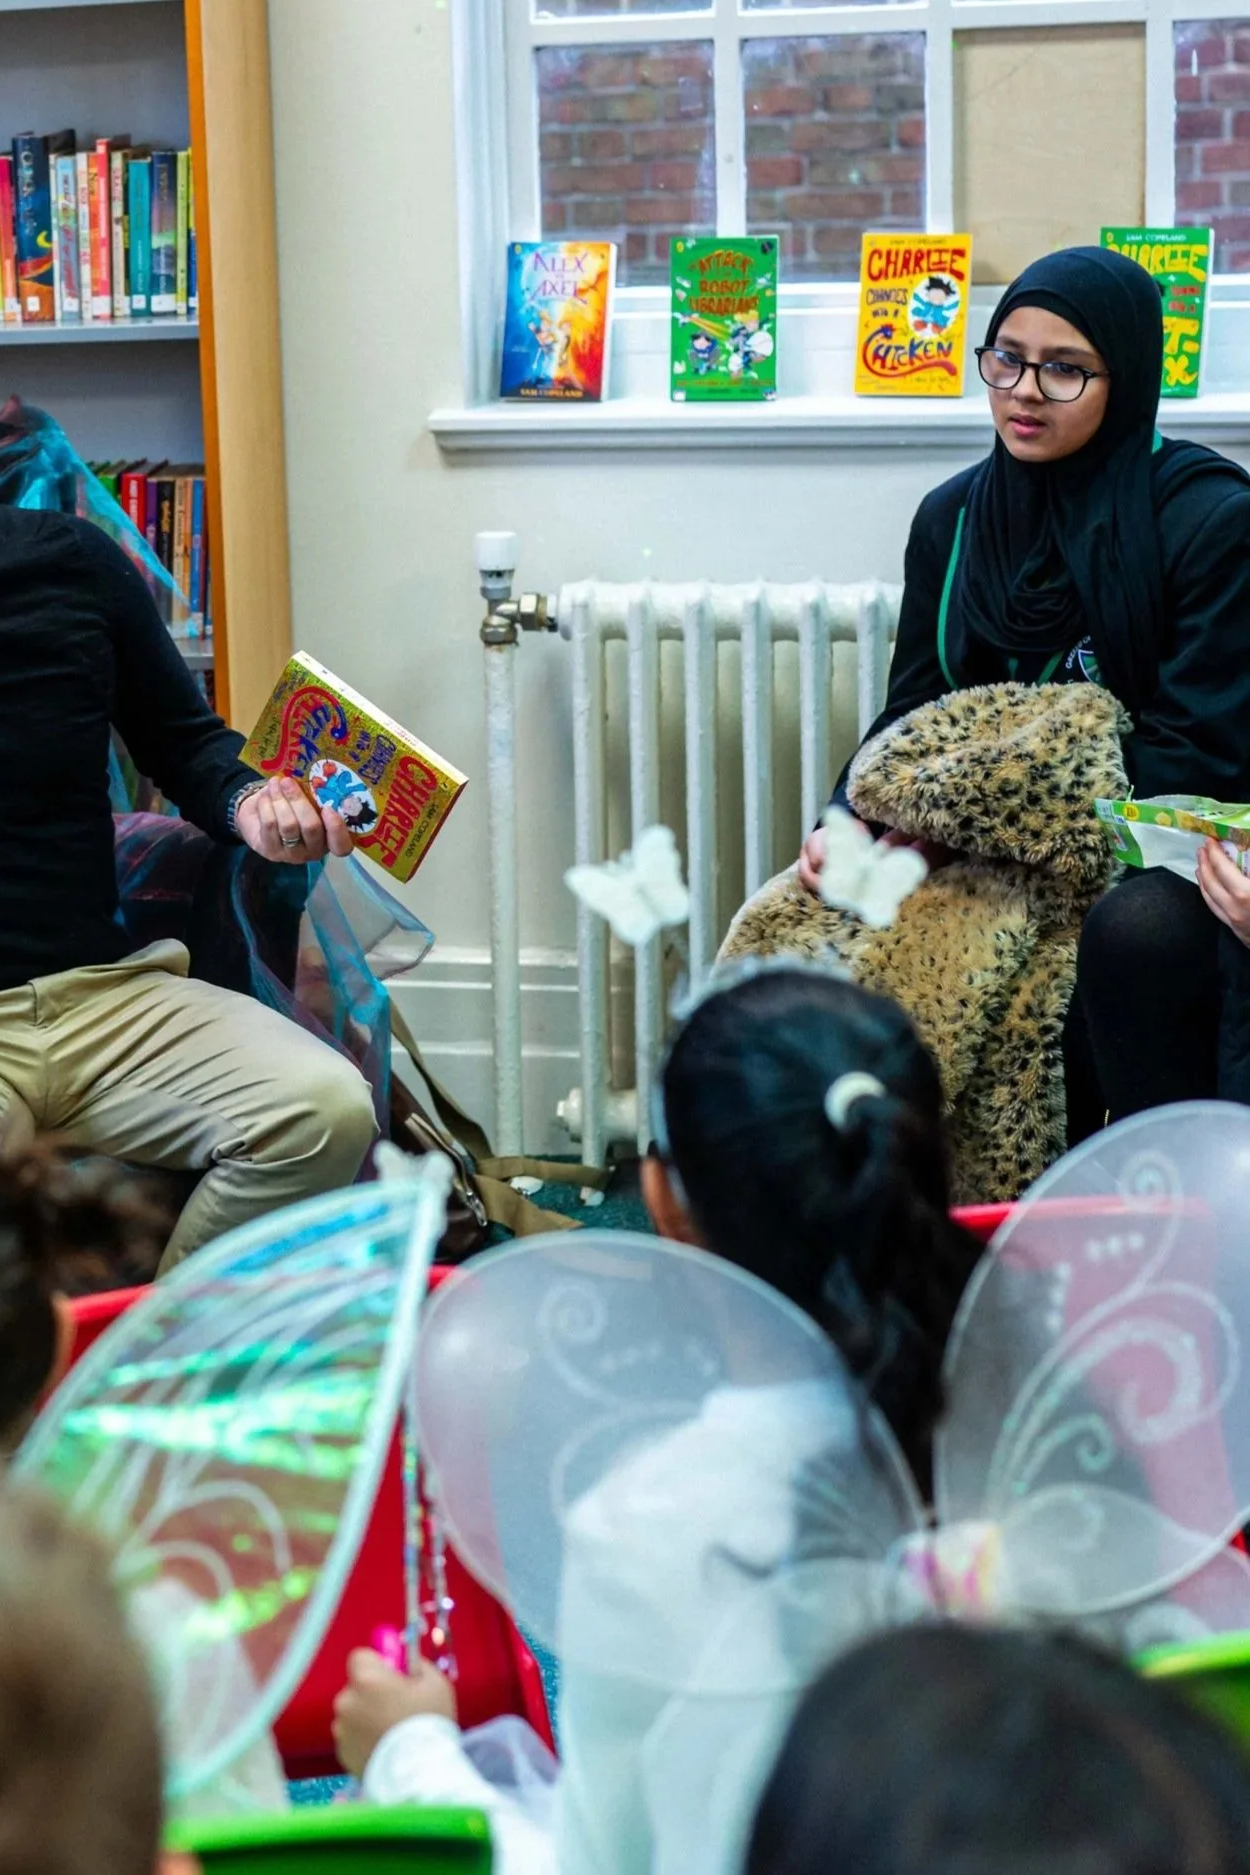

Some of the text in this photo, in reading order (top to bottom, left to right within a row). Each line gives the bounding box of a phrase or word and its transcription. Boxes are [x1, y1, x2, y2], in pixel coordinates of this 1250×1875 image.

[531, 252, 589, 273] ALEX
[867, 248, 966, 282] CHARLIE
[1107, 244, 1208, 283] ARLIE
[529, 279, 588, 305] AXEL
[862, 324, 958, 378] CHICKEN
[356, 755, 438, 868] CHARLIE
[405, 820, 430, 858] COPELAND
